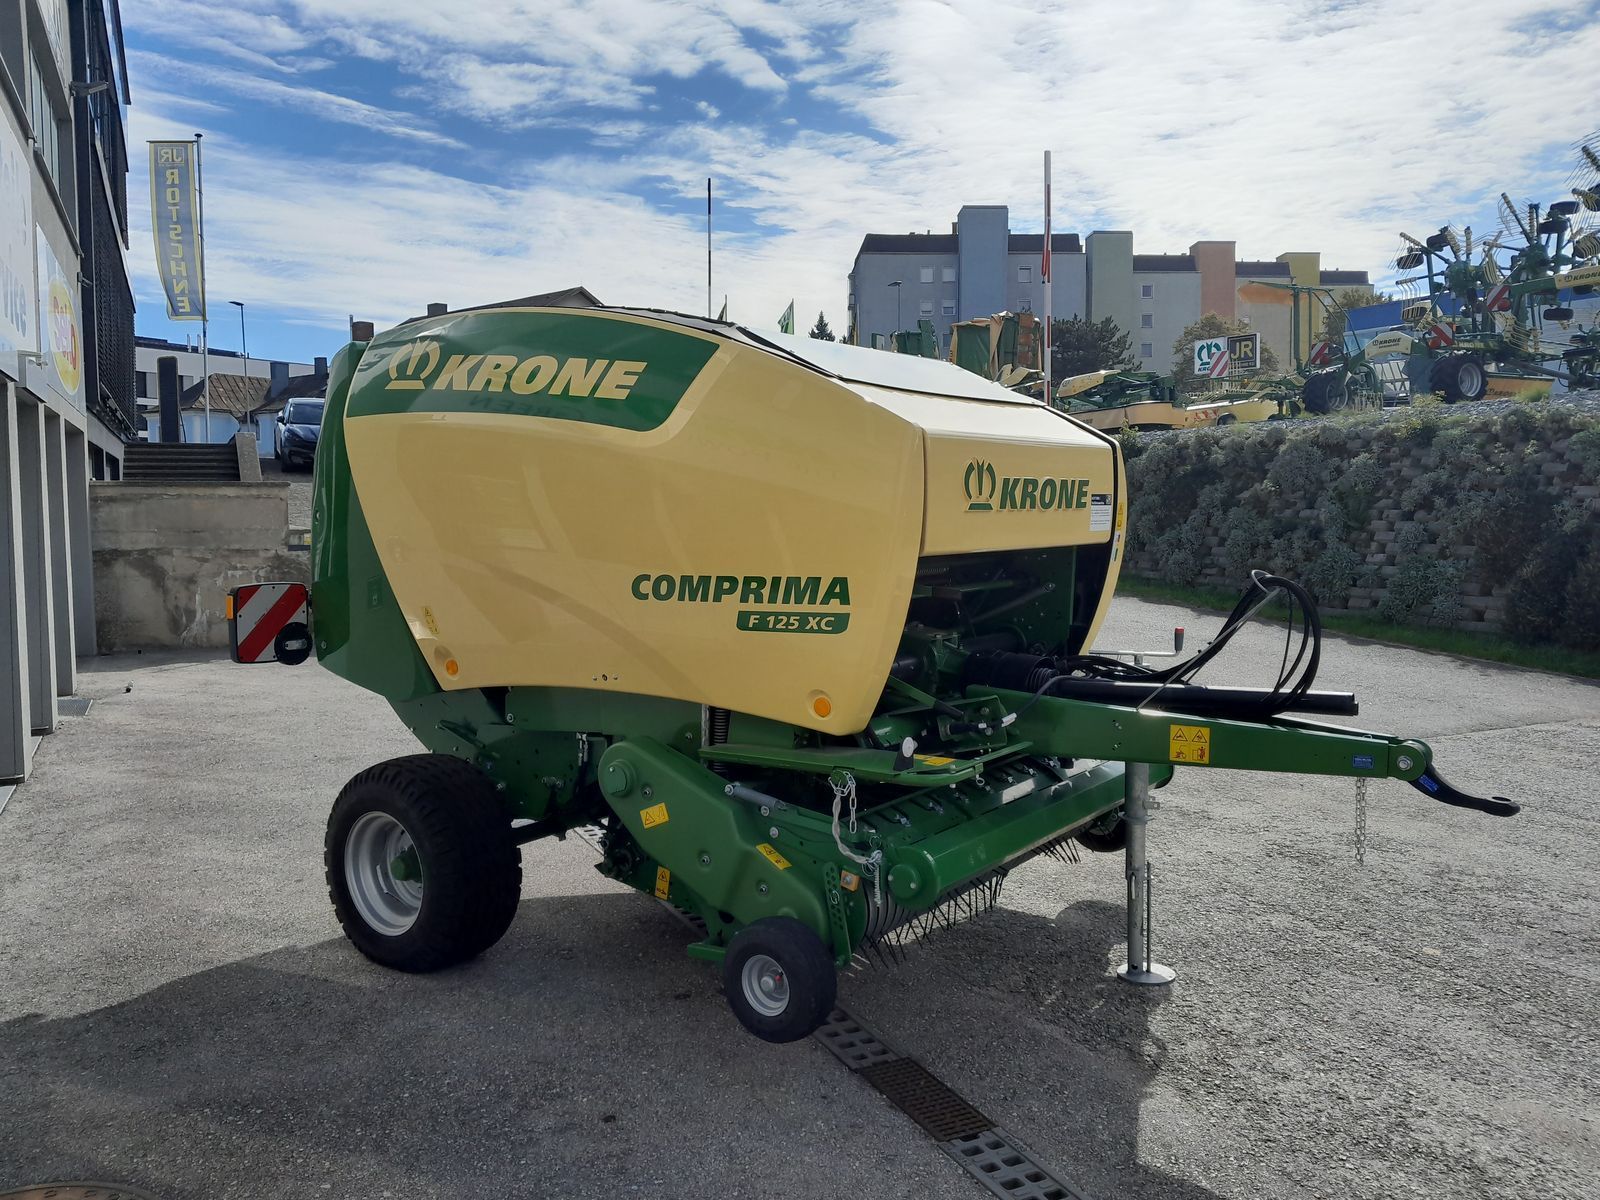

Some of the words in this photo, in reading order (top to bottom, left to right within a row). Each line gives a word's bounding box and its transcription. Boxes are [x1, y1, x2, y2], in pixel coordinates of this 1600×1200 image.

[1231, 340, 1253, 359] JR
[433, 355, 648, 400] KRONE
[999, 477, 1090, 510] KRONE
[631, 573, 851, 606] COMPRIMA
[748, 615, 759, 628] F
[766, 616, 800, 630] 125
[804, 617, 835, 631] XC
